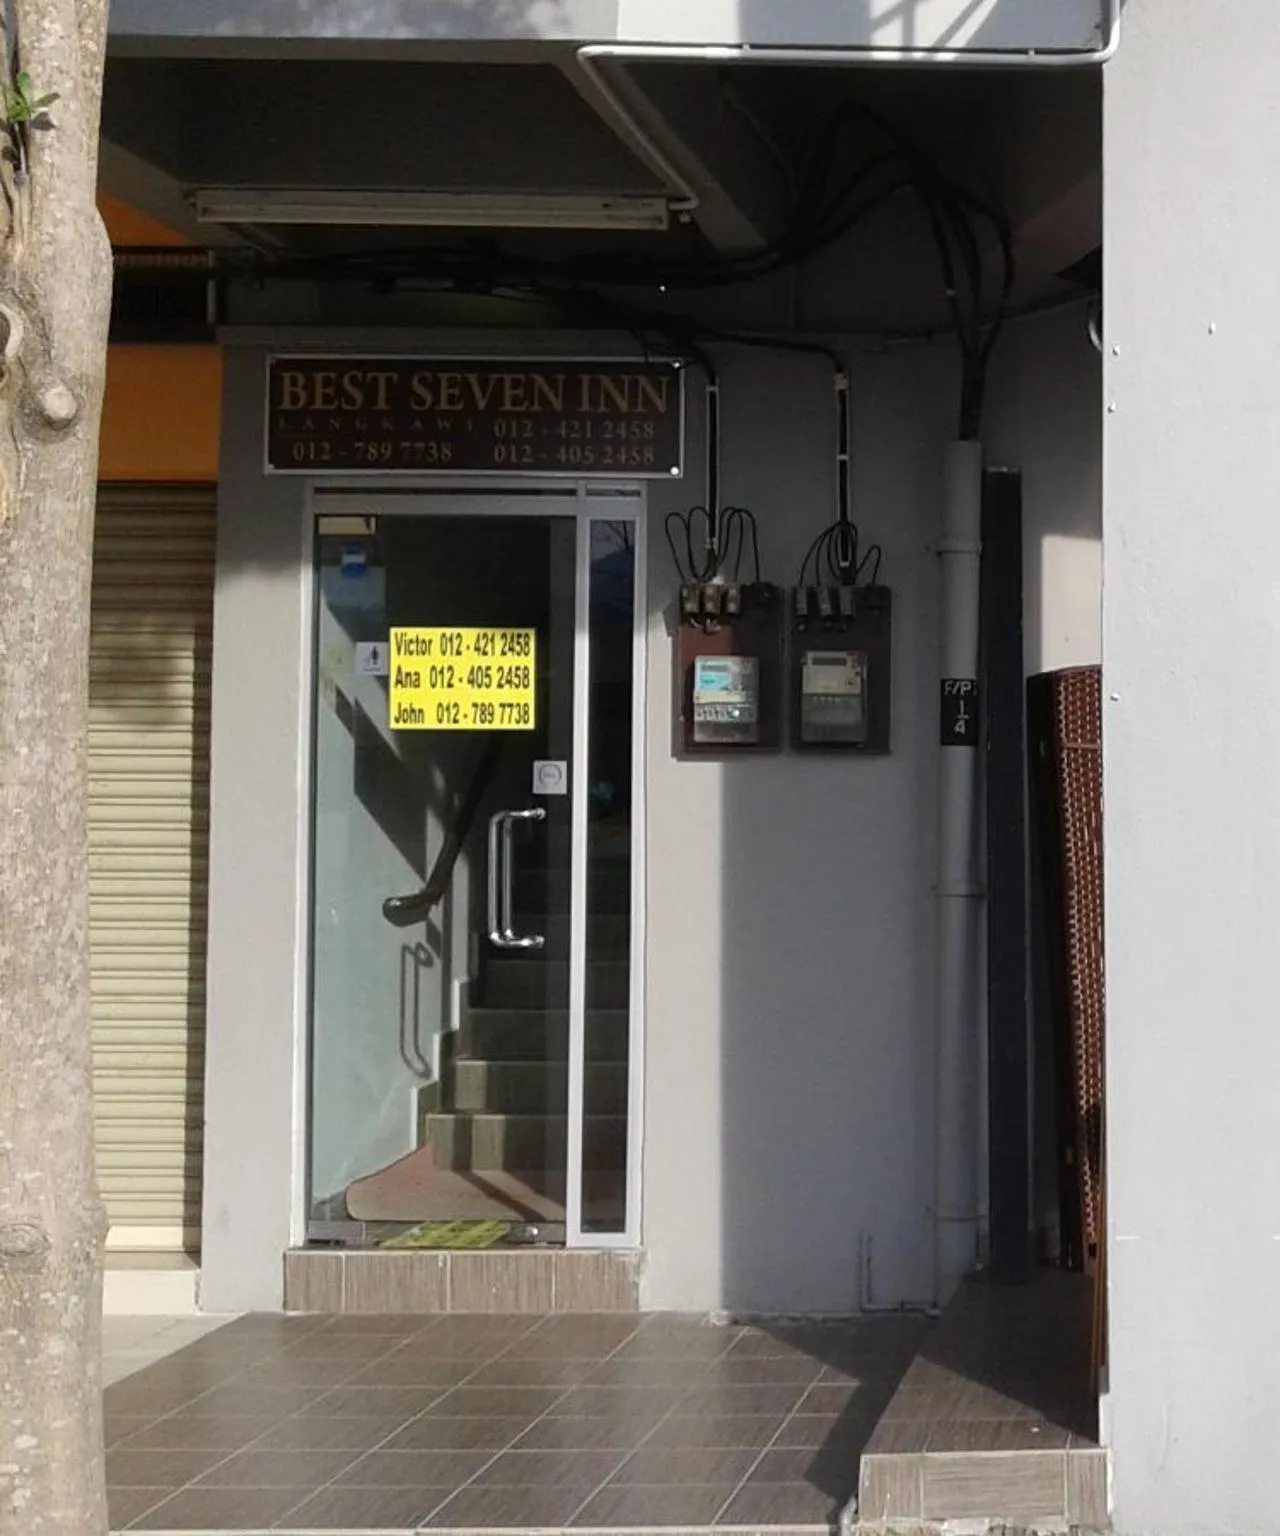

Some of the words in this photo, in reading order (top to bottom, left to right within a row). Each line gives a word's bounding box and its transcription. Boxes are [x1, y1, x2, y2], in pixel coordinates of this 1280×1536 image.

[280, 371, 399, 411] BEST
[410, 371, 565, 413] SEVEN
[571, 374, 673, 414] INN
[493, 419, 534, 438] 012
[555, 419, 594, 438] 421
[602, 420, 655, 439] 2458
[292, 441, 333, 461] 012
[353, 441, 392, 462] 789
[401, 442, 452, 462] 7738
[493, 443, 535, 463] 012
[555, 444, 595, 464] 405
[602, 445, 655, 465] 2458
[394, 632, 433, 656] Victor
[439, 633, 463, 656] 012
[474, 633, 497, 656] 421
[500, 633, 530, 656] 2458
[394, 666, 421, 688] Ana
[429, 665, 455, 689] 012
[467, 665, 492, 689] 405
[496, 665, 530, 689] 2458
[394, 702, 425, 724] John
[436, 703, 460, 724] 012
[472, 703, 494, 724] 789
[500, 703, 530, 724] 7738
